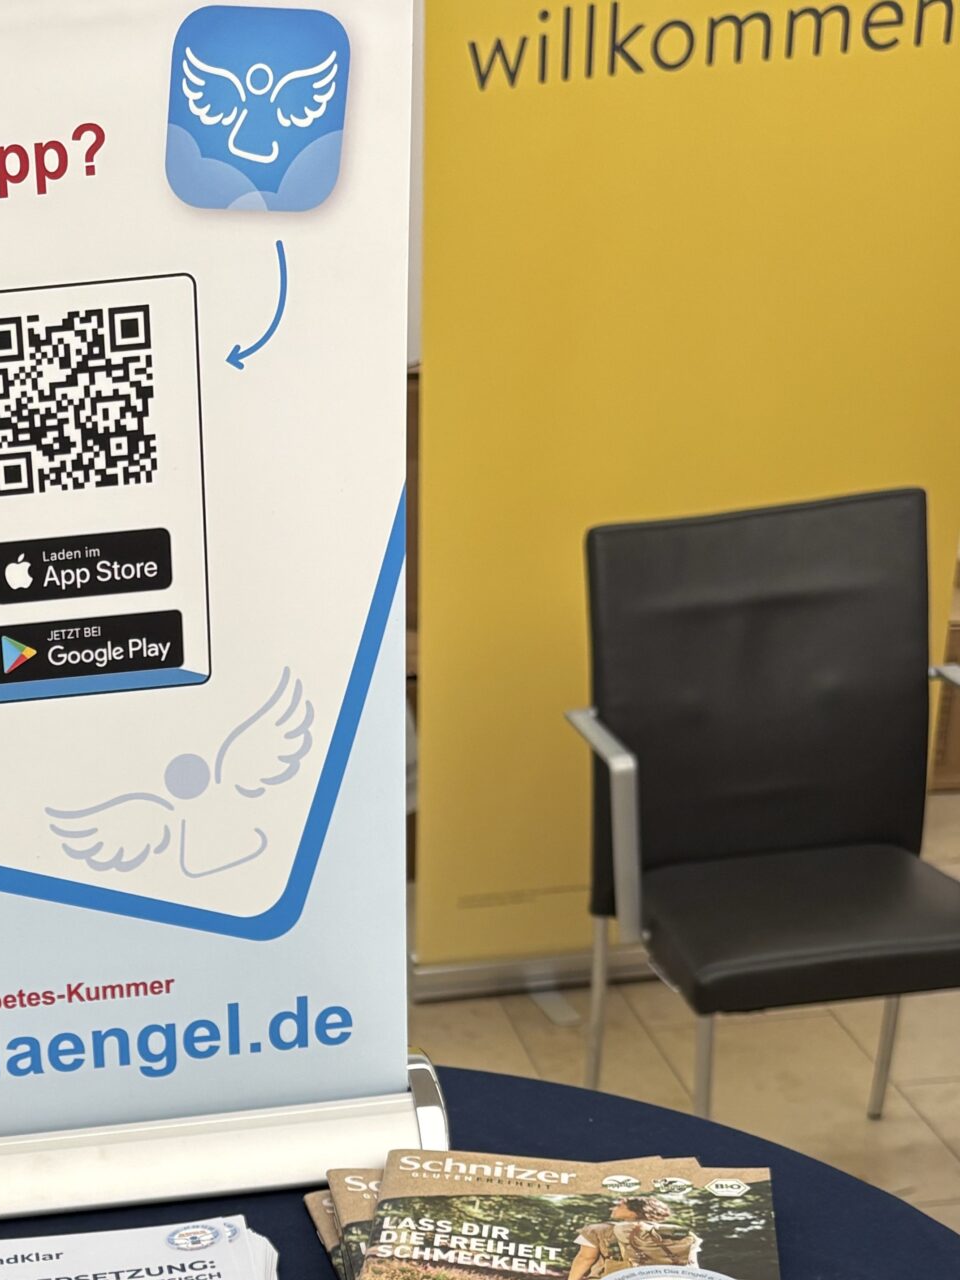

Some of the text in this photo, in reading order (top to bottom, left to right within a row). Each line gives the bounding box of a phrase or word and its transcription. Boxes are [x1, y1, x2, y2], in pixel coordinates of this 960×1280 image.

[468, 0, 953, 90] willkommen
[43, 547, 100, 562] Laden im
[43, 560, 158, 589] App Store
[47, 627, 101, 641] JETZT BEI
[47, 638, 170, 667] Google Play
[399, 1156, 577, 1184] Schnitzer
[382, 1217, 510, 1240] LASS DIR
[376, 1245, 547, 1274] SCHMECKEN
[379, 1231, 561, 1260] DIE FREIHEIT
